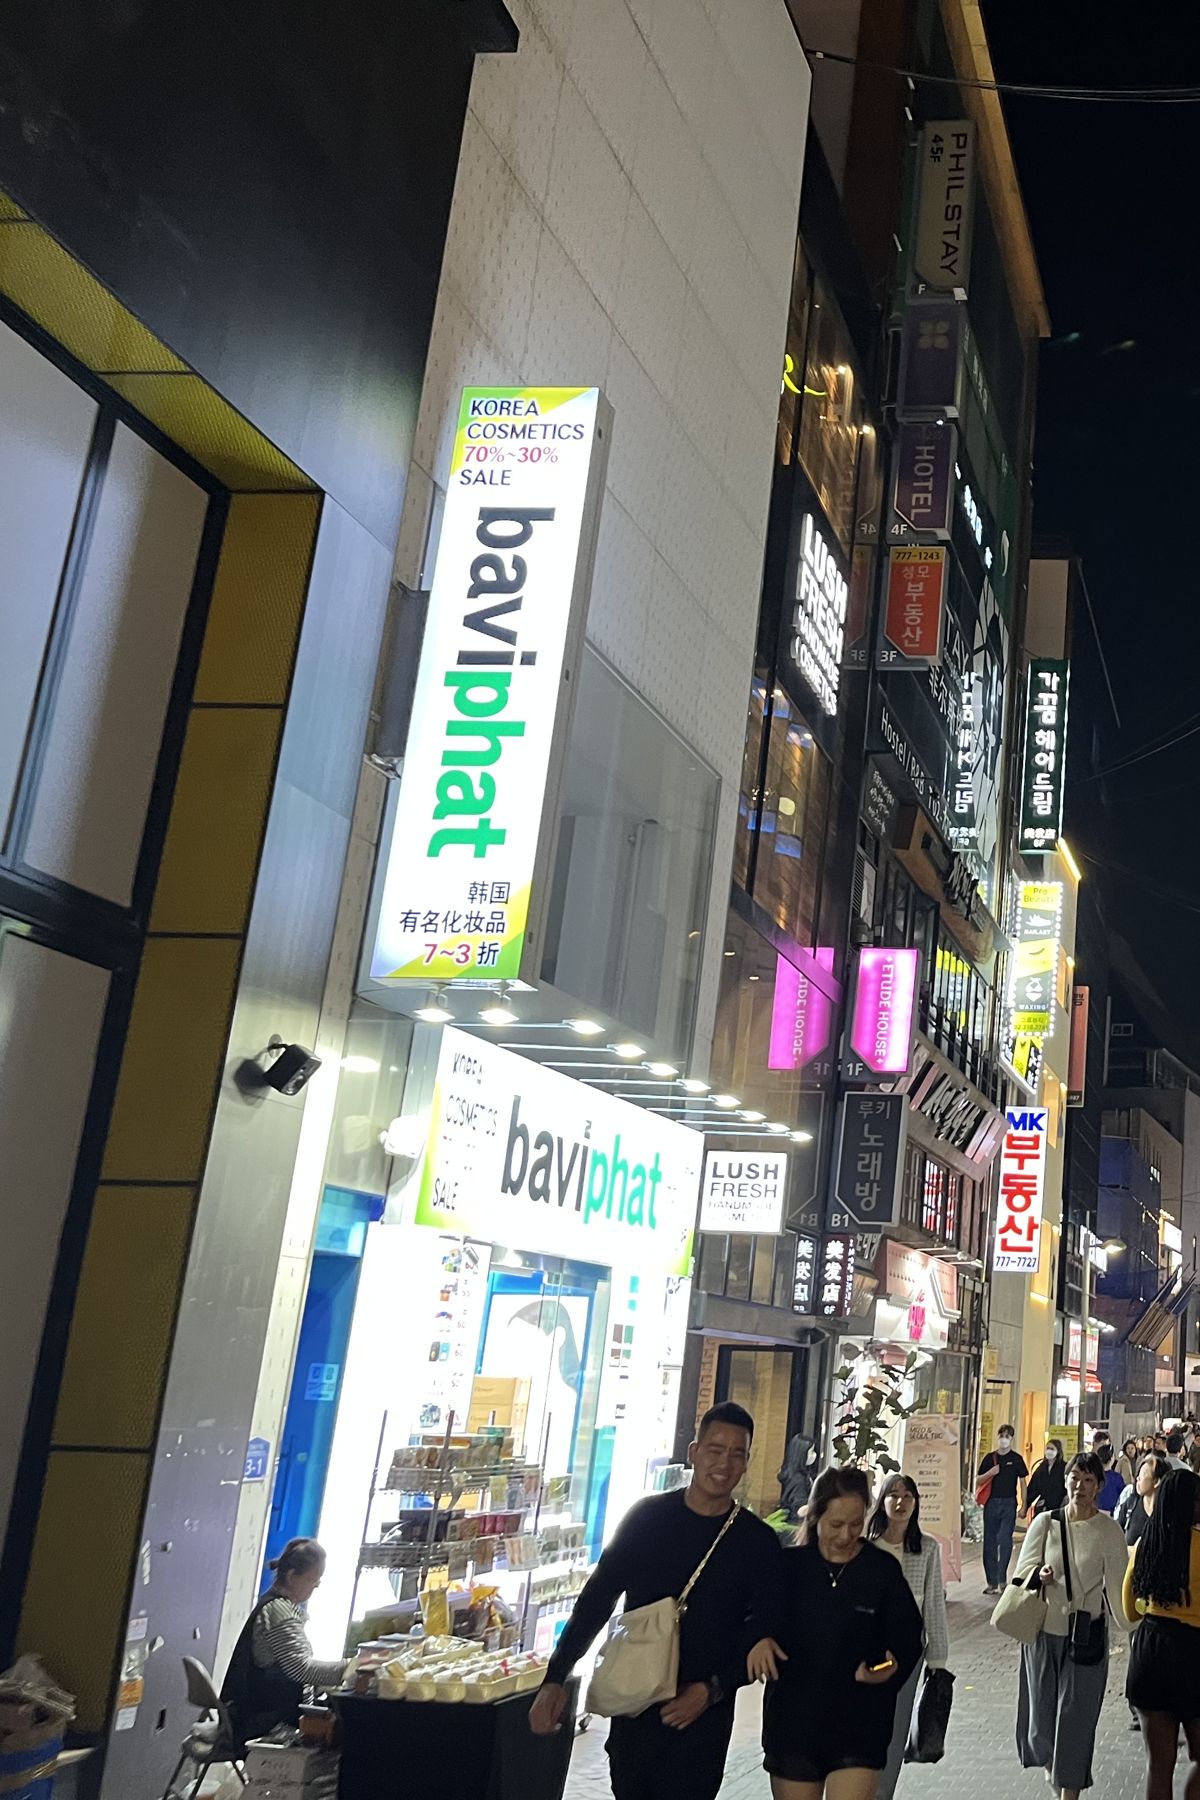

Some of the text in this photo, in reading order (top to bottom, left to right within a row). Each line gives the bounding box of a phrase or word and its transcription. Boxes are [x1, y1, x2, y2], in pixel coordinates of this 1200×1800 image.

[940, 132, 968, 275] PHILSTAY
[469, 398, 539, 417] KOREA
[466, 422, 585, 441] COSMETICS
[463, 445, 558, 464] 70%~30%
[460, 469, 512, 486] SALE
[911, 446, 935, 521] HOTEL
[891, 523, 908, 535] 4F
[895, 551, 940, 560] 777-1243
[801, 513, 849, 624] LUSH
[902, 565, 930, 579] 성모
[902, 582, 925, 647] 부동산
[880, 650, 897, 662] 3F
[427, 506, 556, 858] baviphat
[881, 706, 907, 763] Hostel
[467, 881, 510, 904] 韩国
[399, 910, 506, 934] 有名化妆品
[874, 964, 894, 1057] ETUDE HOUSE
[847, 1062, 864, 1076] 1F
[858, 1101, 891, 1119] 루키
[1007, 1112, 1046, 1131] MK
[501, 1094, 662, 1229] baviphat
[712, 1162, 778, 1179] LUSH
[854, 1123, 884, 1211] 노래방
[711, 1182, 777, 1198] FRESH
[999, 1134, 1039, 1252] 부동산
[831, 1213, 849, 1227] B1
[822, 1240, 844, 1302] 美发店
[996, 1256, 1036, 1268] 777-7727
[824, 1305, 835, 1314] 6F
